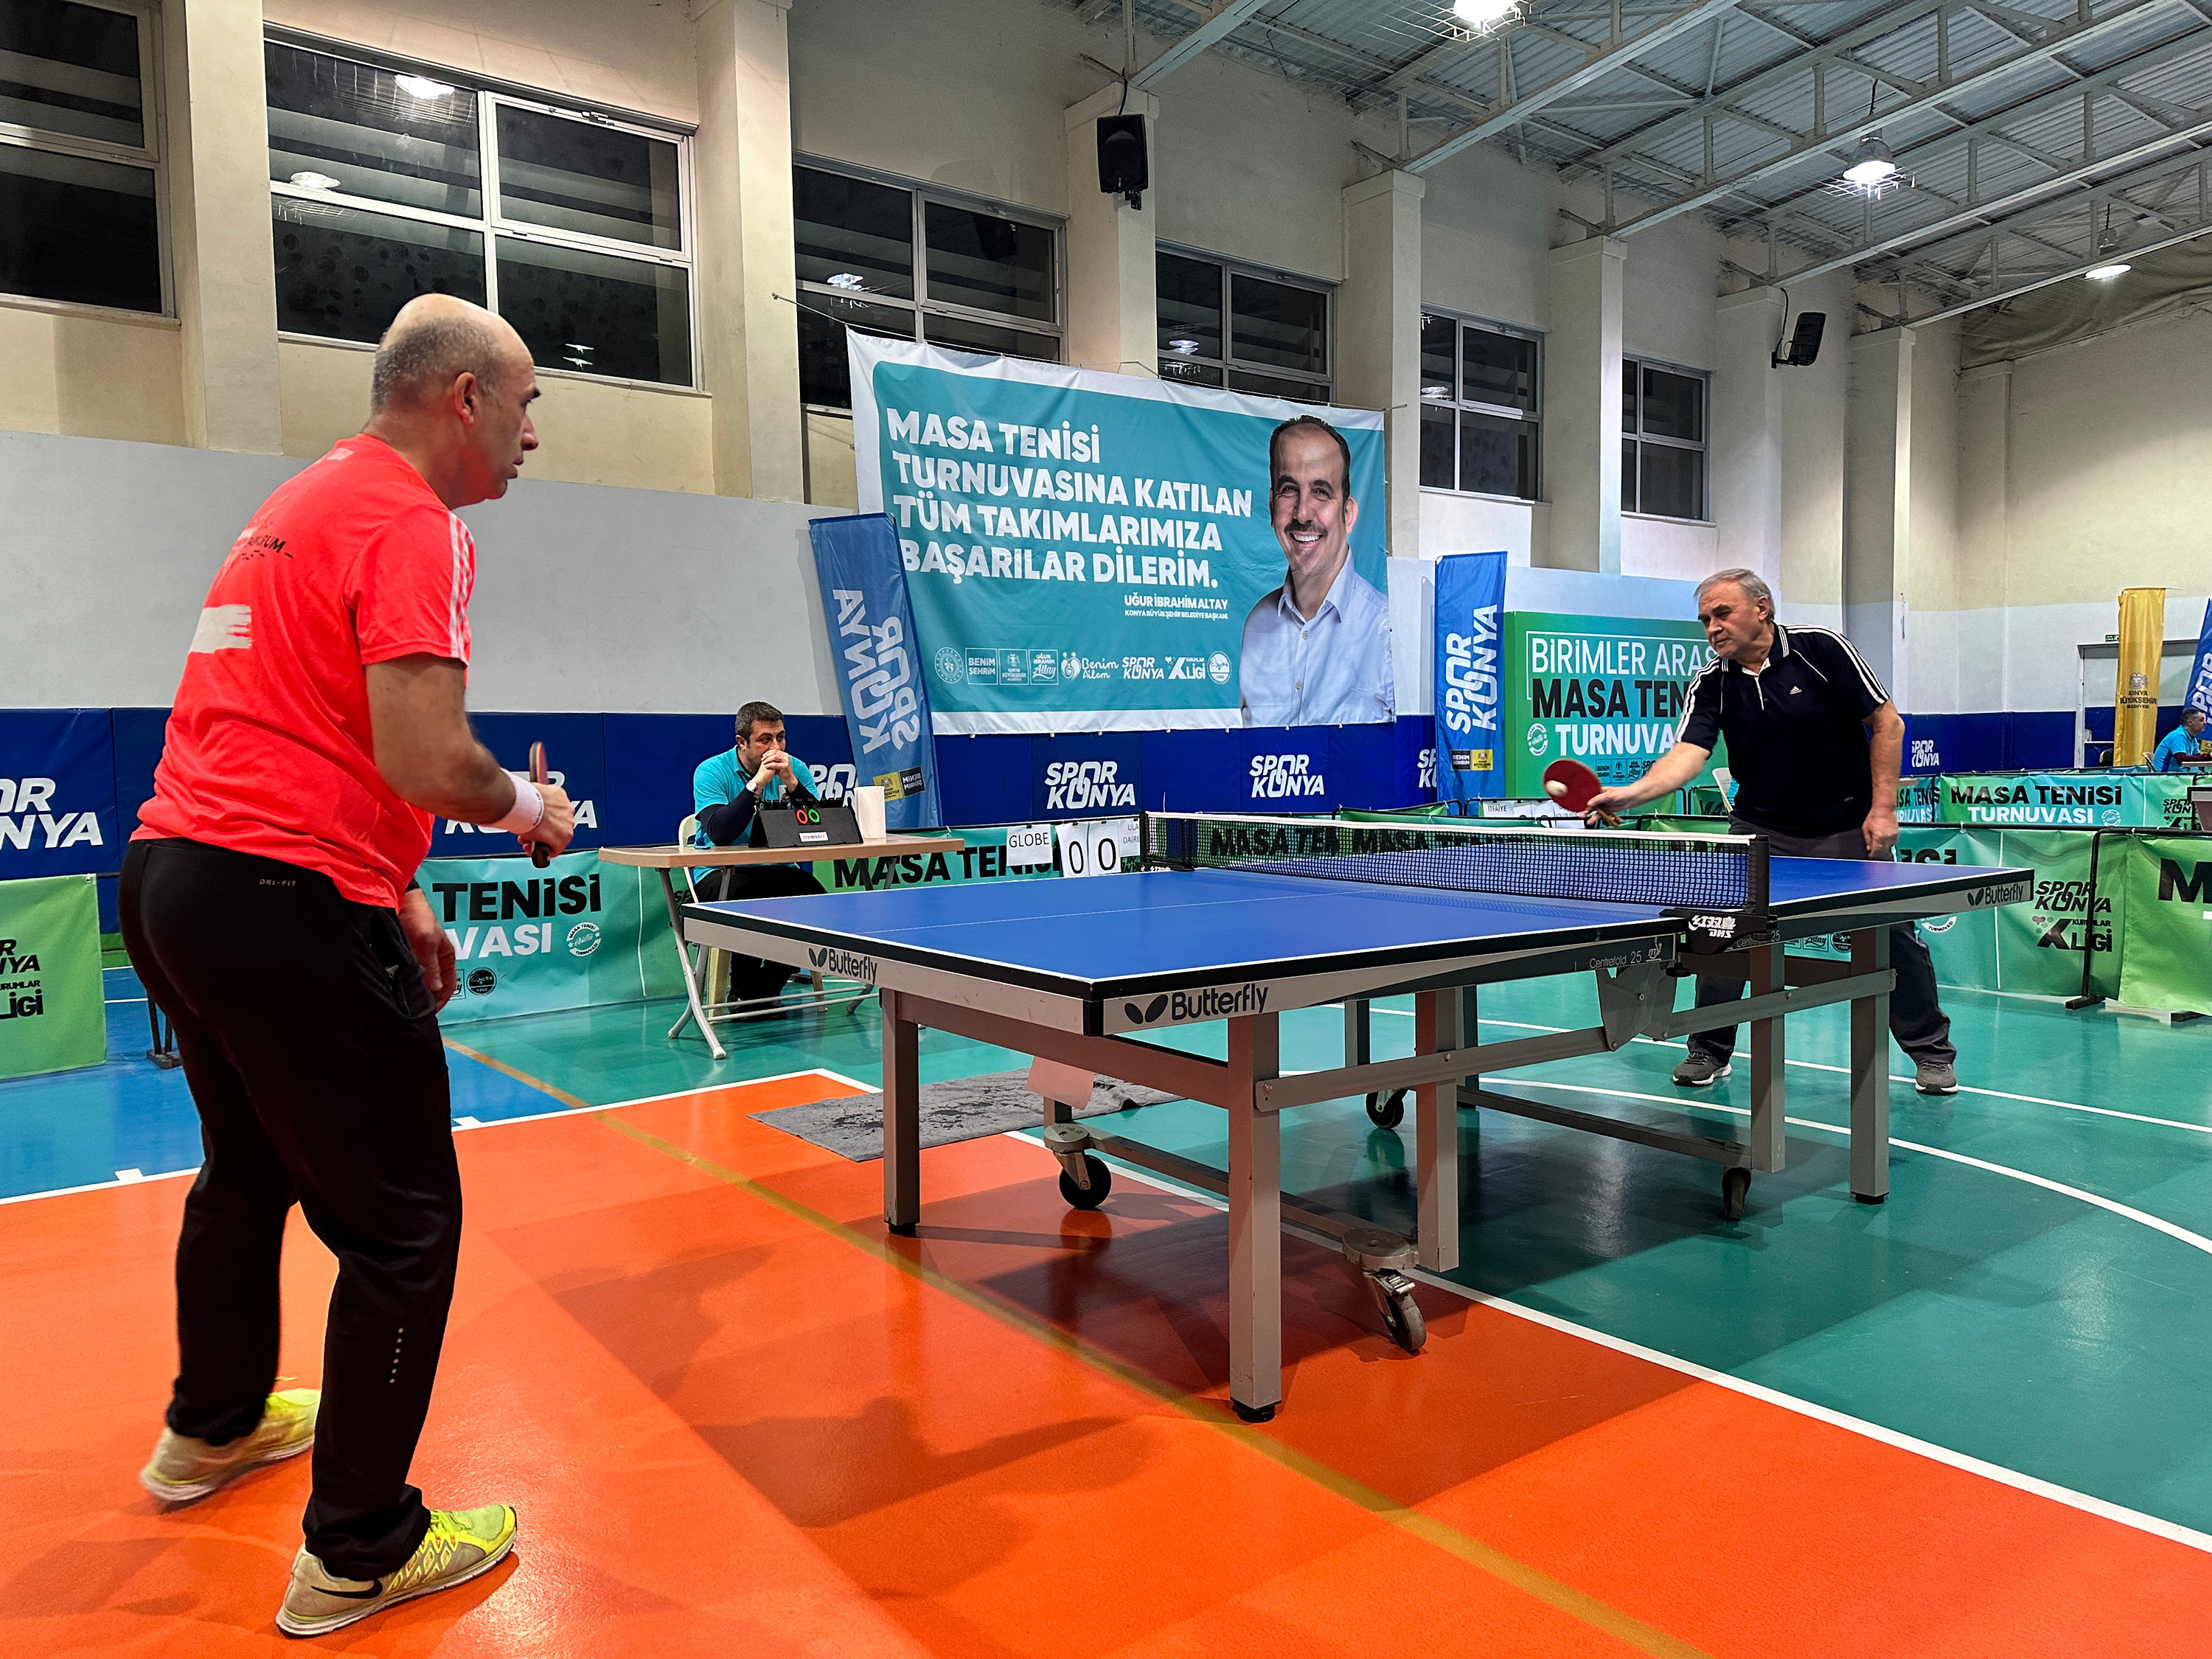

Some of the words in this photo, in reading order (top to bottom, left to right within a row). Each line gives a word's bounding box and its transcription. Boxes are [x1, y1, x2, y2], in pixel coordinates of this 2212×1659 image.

[886, 408, 993, 453] MASA
[998, 420, 1100, 464] TENİSİ
[892, 451, 1129, 506] TURNUVASINA
[1134, 477, 1252, 518] KATILAN
[893, 490, 972, 534] TÜM
[976, 504, 1222, 551] TAKIMLARIMIZA
[900, 539, 1086, 584] BAŞARILAR
[1093, 545, 1218, 588] DİLERİM.
[1124, 591, 1153, 607] UĞUR
[1154, 593, 1197, 608] İBRAHİM
[1197, 598, 1228, 610] ALTAY
[968, 657, 995, 666] BENİM
[1082, 658, 1119, 669] Benim
[1469, 604, 1498, 731] KONYA
[1531, 637, 1646, 675] BİRİMLER
[969, 667, 995, 675] ŞEHRİM
[1123, 665, 1164, 680] KONYA
[1532, 678, 1630, 718] MASA
[1634, 680, 1691, 718] TEN
[1554, 723, 1676, 757] TURNUVA
[1044, 761, 1118, 786] SPOR
[1249, 754, 1310, 776] SPOR
[1047, 780, 1136, 809] KONYA
[1251, 771, 1325, 798] KONYA
[1950, 785, 2031, 804] MASA
[2035, 785, 2121, 806] TENİSİ
[1967, 806, 2093, 824] TURNUVASI
[1009, 832, 1050, 848] GLOBE
[1068, 841, 1085, 874] 0
[1098, 838, 1117, 871] 0
[259, 878, 296, 886] DRI-FIT
[1985, 883, 2023, 905] Butterfly
[432, 873, 602, 922] TENİSİ
[1708, 928, 1735, 938] DHS
[1770, 929, 1781, 942] 25
[829, 948, 877, 984] Butterfly
[1589, 954, 1627, 969] Centrefold
[1630, 950, 1642, 964] 25
[1171, 983, 1269, 1021] Butterfly
